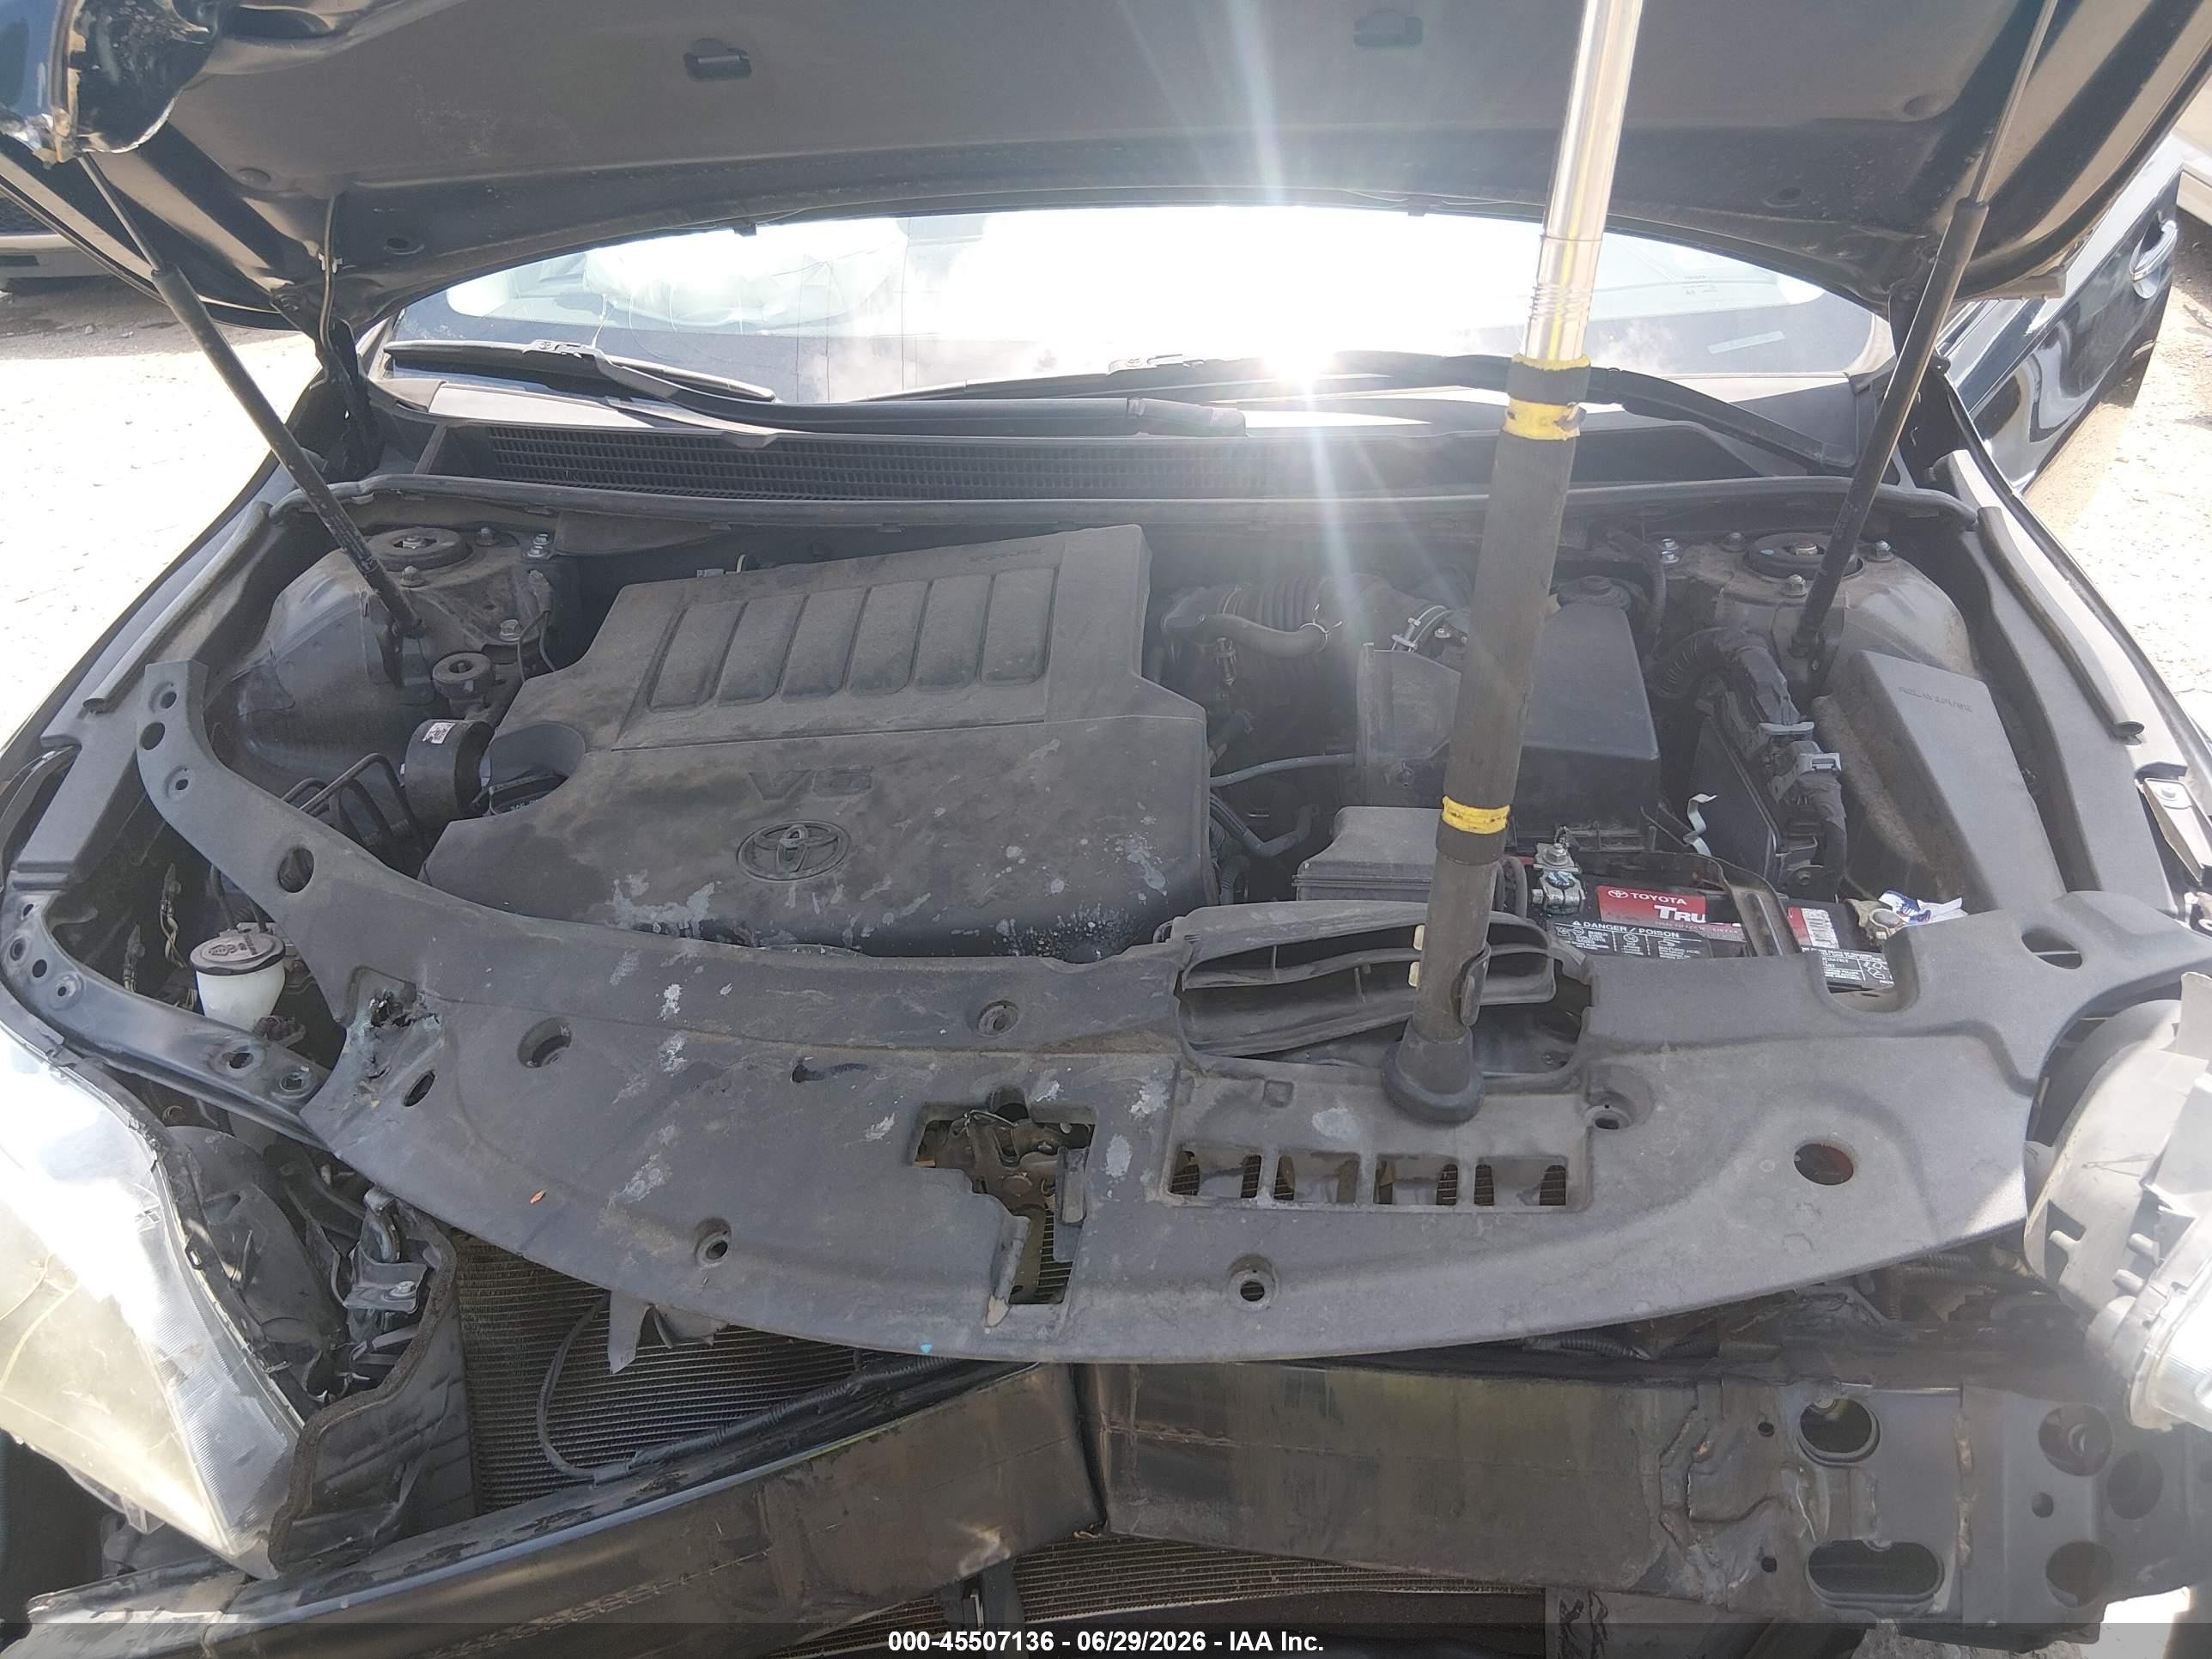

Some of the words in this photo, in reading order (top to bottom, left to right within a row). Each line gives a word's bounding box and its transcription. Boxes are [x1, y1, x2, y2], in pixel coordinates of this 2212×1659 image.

[748, 767, 873, 800] V6
[1630, 892, 1687, 906] TOYOTA
[1654, 904, 1707, 924] TRU
[1583, 921, 1627, 933] DANGER
[1638, 928, 1680, 939] POISON
